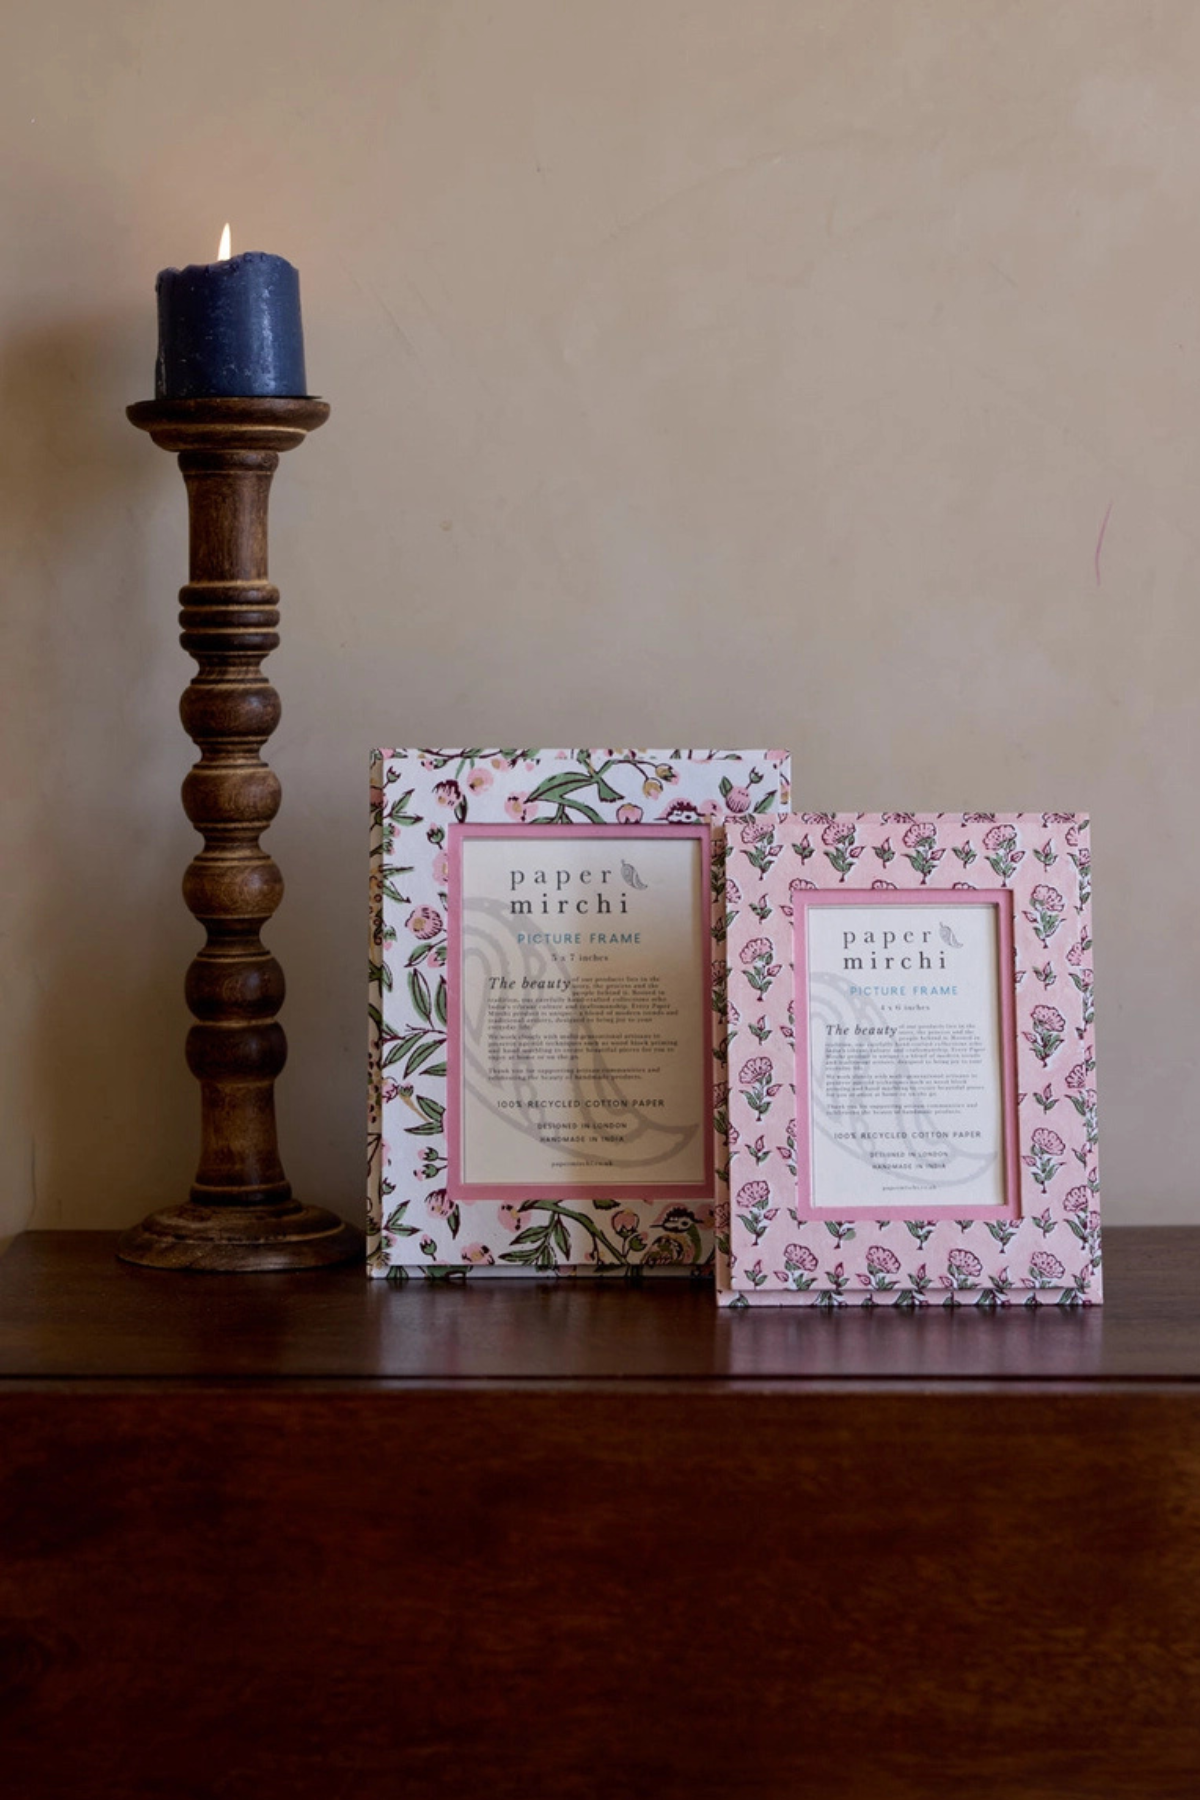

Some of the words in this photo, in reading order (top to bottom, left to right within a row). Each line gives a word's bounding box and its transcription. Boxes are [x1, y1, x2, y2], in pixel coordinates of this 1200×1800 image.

[510, 869, 612, 891] paper
[509, 893, 628, 915] mirchi
[517, 933, 581, 944] PICTURE
[589, 933, 641, 944] FRAME
[843, 930, 932, 949] paper
[579, 954, 609, 962] inches
[843, 951, 947, 970] mirchi
[489, 977, 516, 989] The
[521, 976, 571, 992] beauty
[849, 986, 906, 996] PICTURE
[913, 986, 958, 996] FRAME
[825, 1024, 850, 1036] The
[854, 1024, 898, 1038] beauty
[497, 1099, 522, 1108] 100%
[527, 1099, 581, 1108] RECYCLED
[585, 1099, 628, 1108] COTTON
[632, 1099, 665, 1108] PAPER
[537, 1122, 578, 1130] DESIGNED
[581, 1122, 590, 1130] IN
[593, 1122, 628, 1130] LONDON
[834, 1131, 857, 1139] 100%
[860, 1131, 908, 1139] RECYCLED
[911, 1131, 949, 1139] COTTON
[952, 1131, 982, 1139] PAPER
